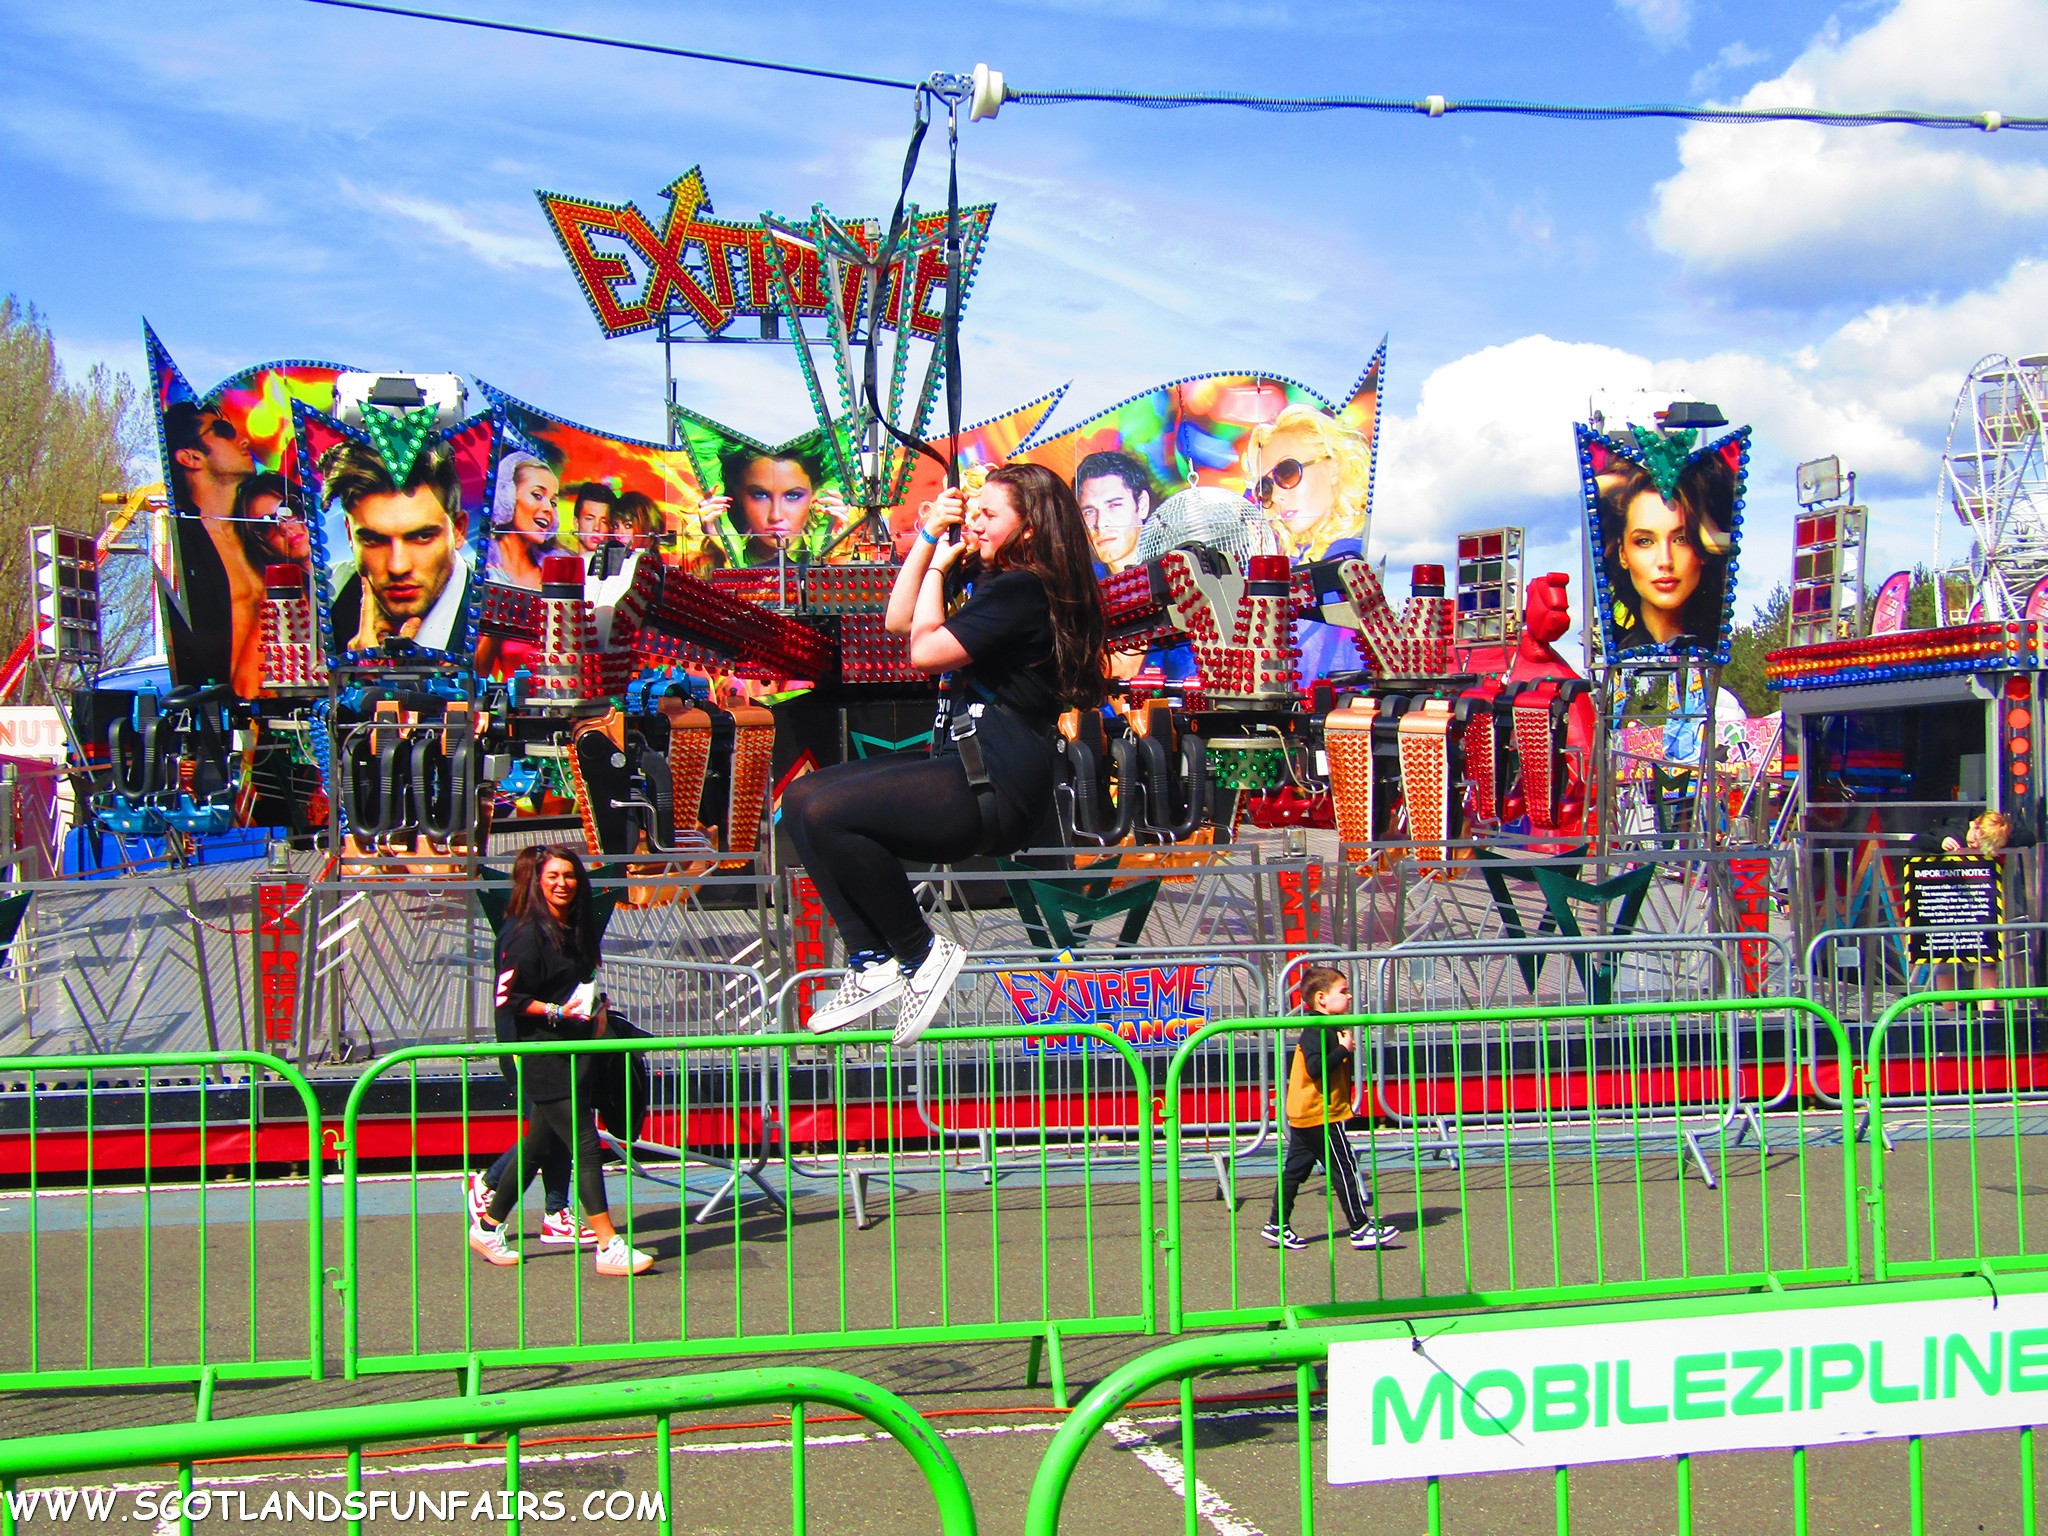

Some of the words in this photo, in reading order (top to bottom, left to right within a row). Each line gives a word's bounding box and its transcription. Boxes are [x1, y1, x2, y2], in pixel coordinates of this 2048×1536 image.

[1914, 869, 1961, 878] IMPORTANT
[1961, 868, 1991, 877] NOTICE
[259, 883, 305, 1040] EXTREME
[993, 950, 1214, 1024] EXTREME
[1026, 1017, 1206, 1049] ENRANCE
[1370, 1327, 2048, 1446] MOBILEZIPLINE
